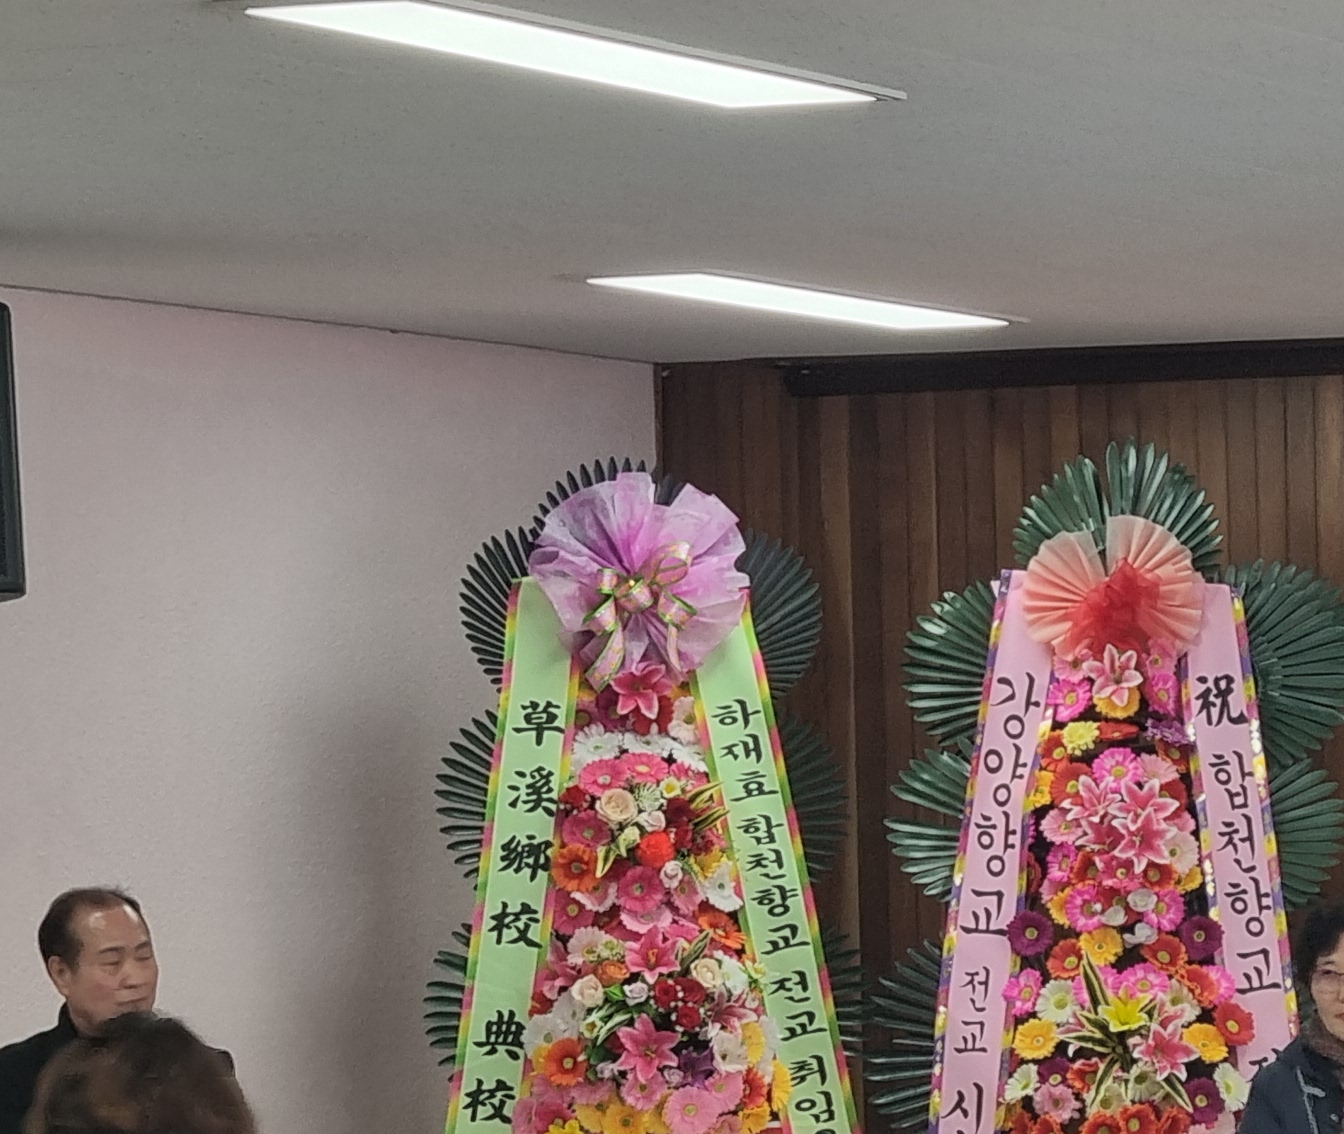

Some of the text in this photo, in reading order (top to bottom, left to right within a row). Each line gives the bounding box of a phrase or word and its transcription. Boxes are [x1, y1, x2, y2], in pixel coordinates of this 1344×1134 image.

[711, 698, 780, 801] 하재효
[1194, 674, 1247, 728] 祝
[960, 672, 1040, 937] 강양향교
[735, 814, 811, 956] 합천향교
[1208, 750, 1282, 995] 합천향교
[769, 969, 829, 1042] 전교
[953, 966, 991, 1055] 전교
